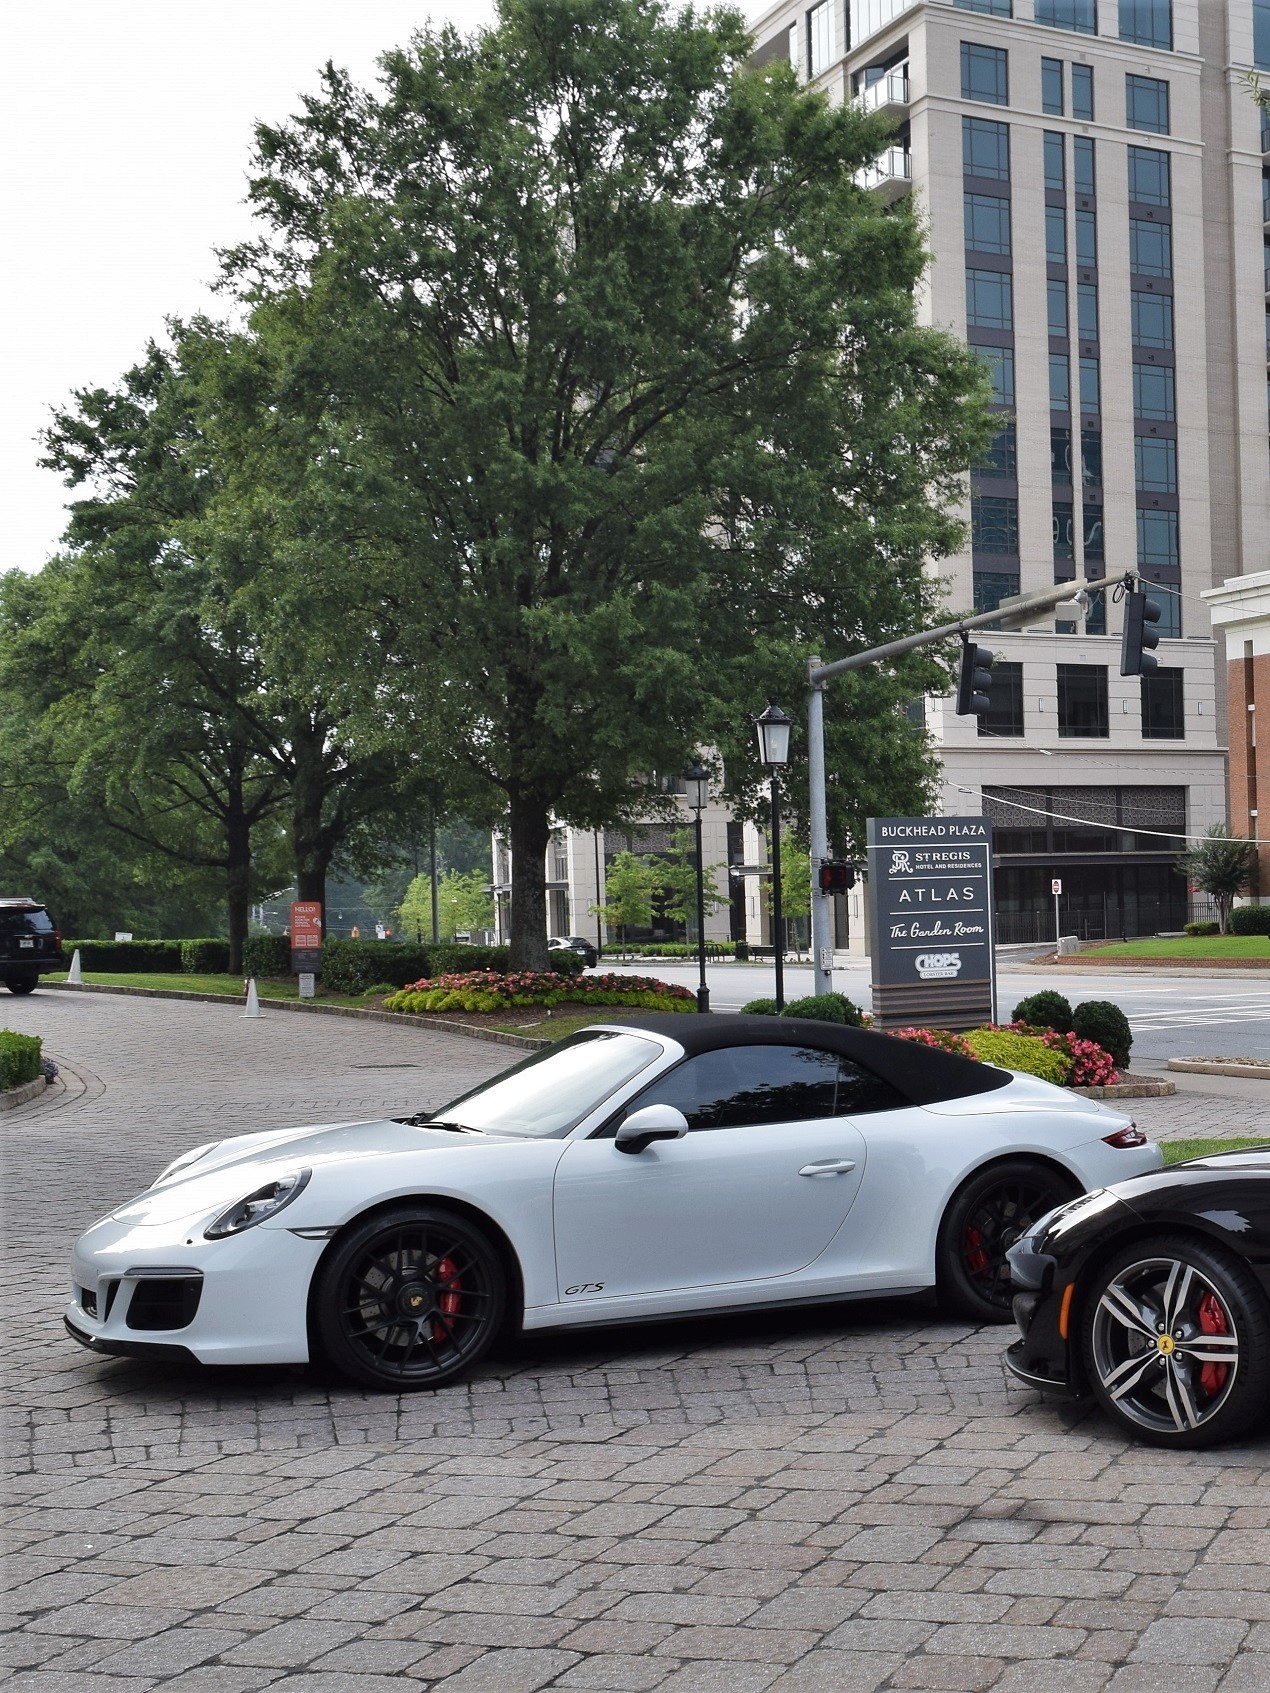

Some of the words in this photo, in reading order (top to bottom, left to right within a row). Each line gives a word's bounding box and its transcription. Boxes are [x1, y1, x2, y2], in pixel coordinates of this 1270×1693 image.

[882, 826, 945, 836] BUCKHEAD
[950, 826, 985, 835] PLAZA
[932, 852, 970, 860] REGIS
[899, 887, 974, 902] ATLAS
[890, 924, 908, 938] The
[910, 921, 952, 938] Garden
[954, 922, 984, 936] Room
[915, 953, 961, 971] CHOPS
[565, 1282, 605, 1295] GTS
